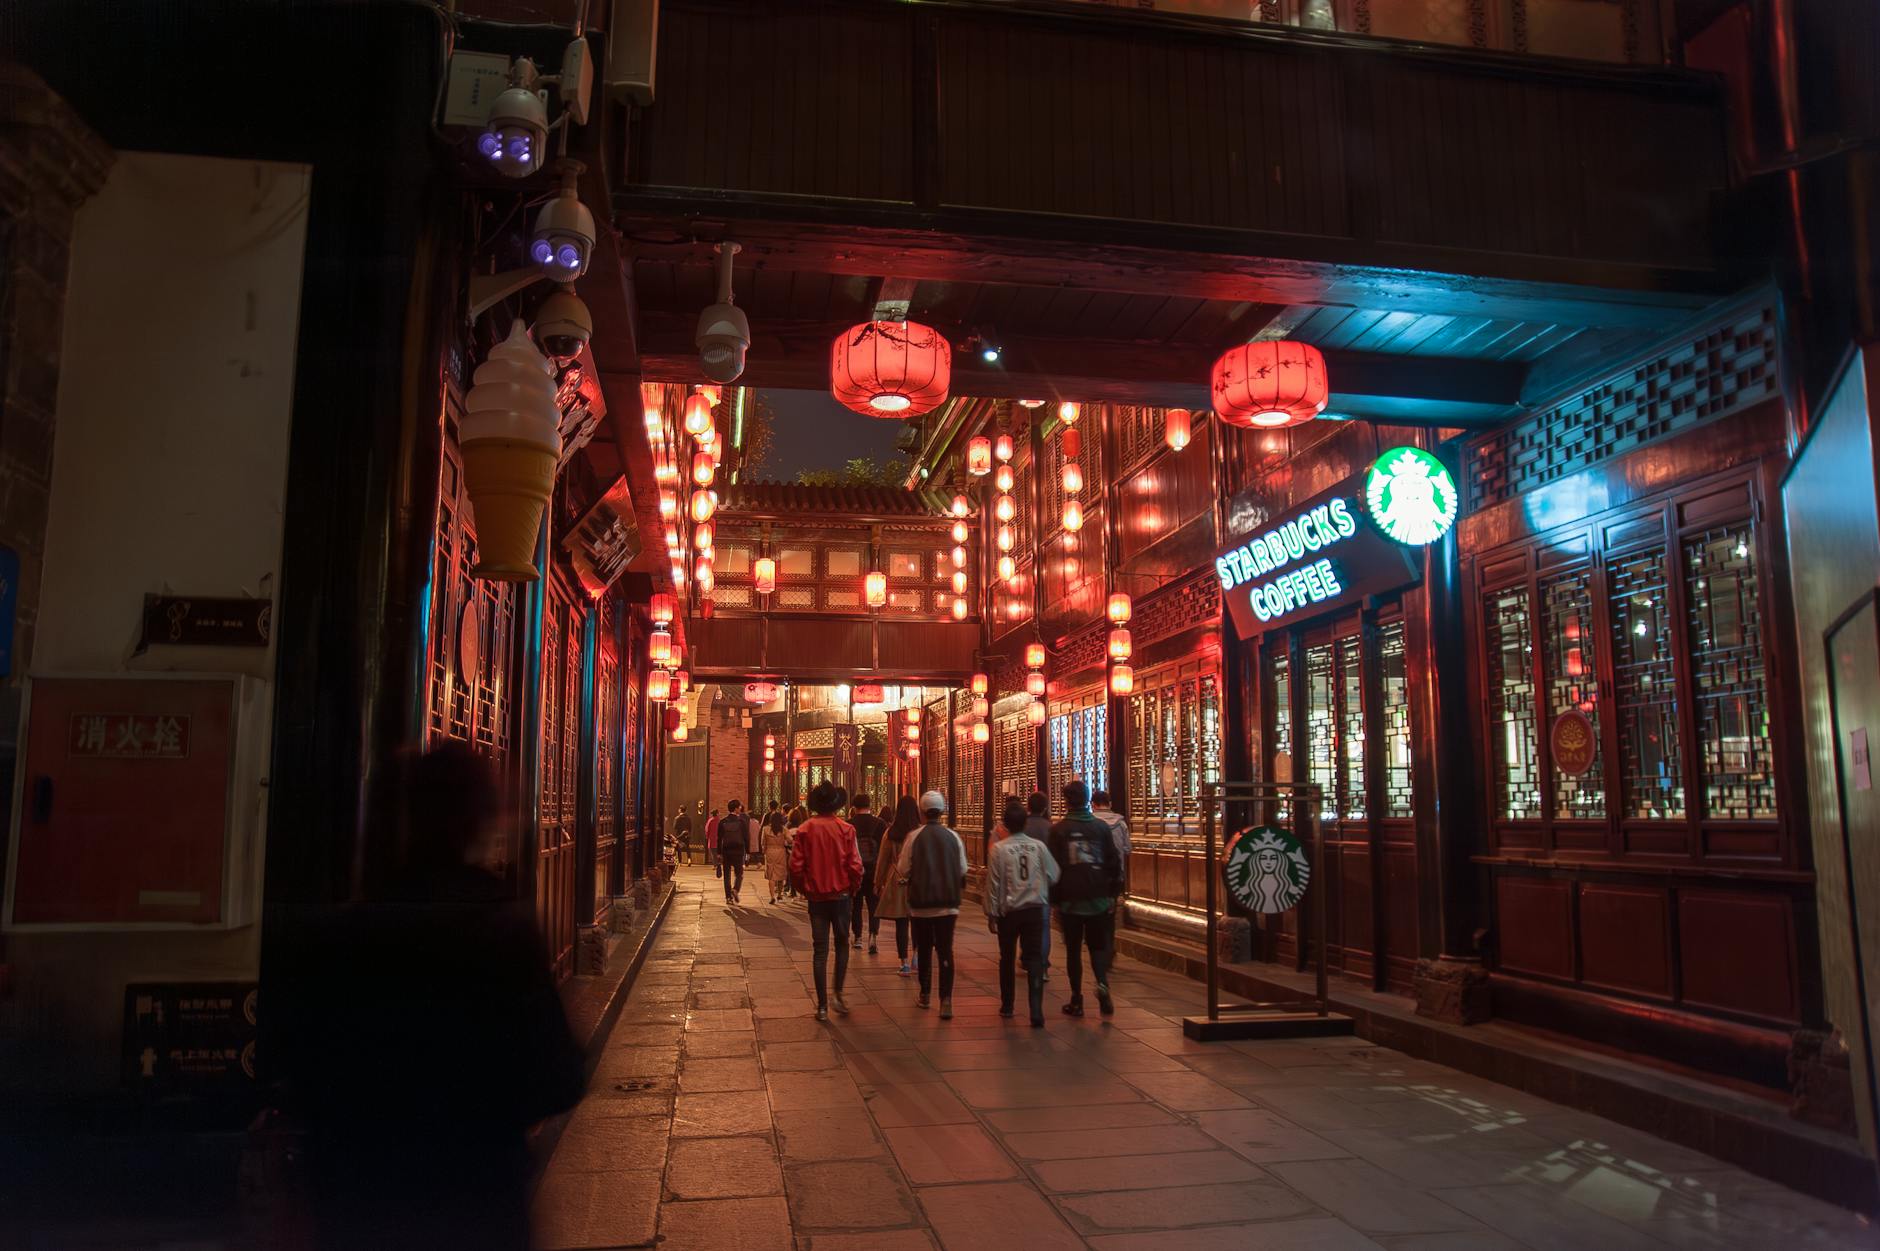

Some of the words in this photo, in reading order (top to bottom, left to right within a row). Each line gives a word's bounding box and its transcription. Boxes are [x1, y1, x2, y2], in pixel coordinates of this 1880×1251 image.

[1215, 497, 1356, 590] STARBUCKS
[1250, 558, 1342, 622] COFFEE
[78, 716, 183, 755] 消火栓
[1019, 855, 1029, 881] 8
